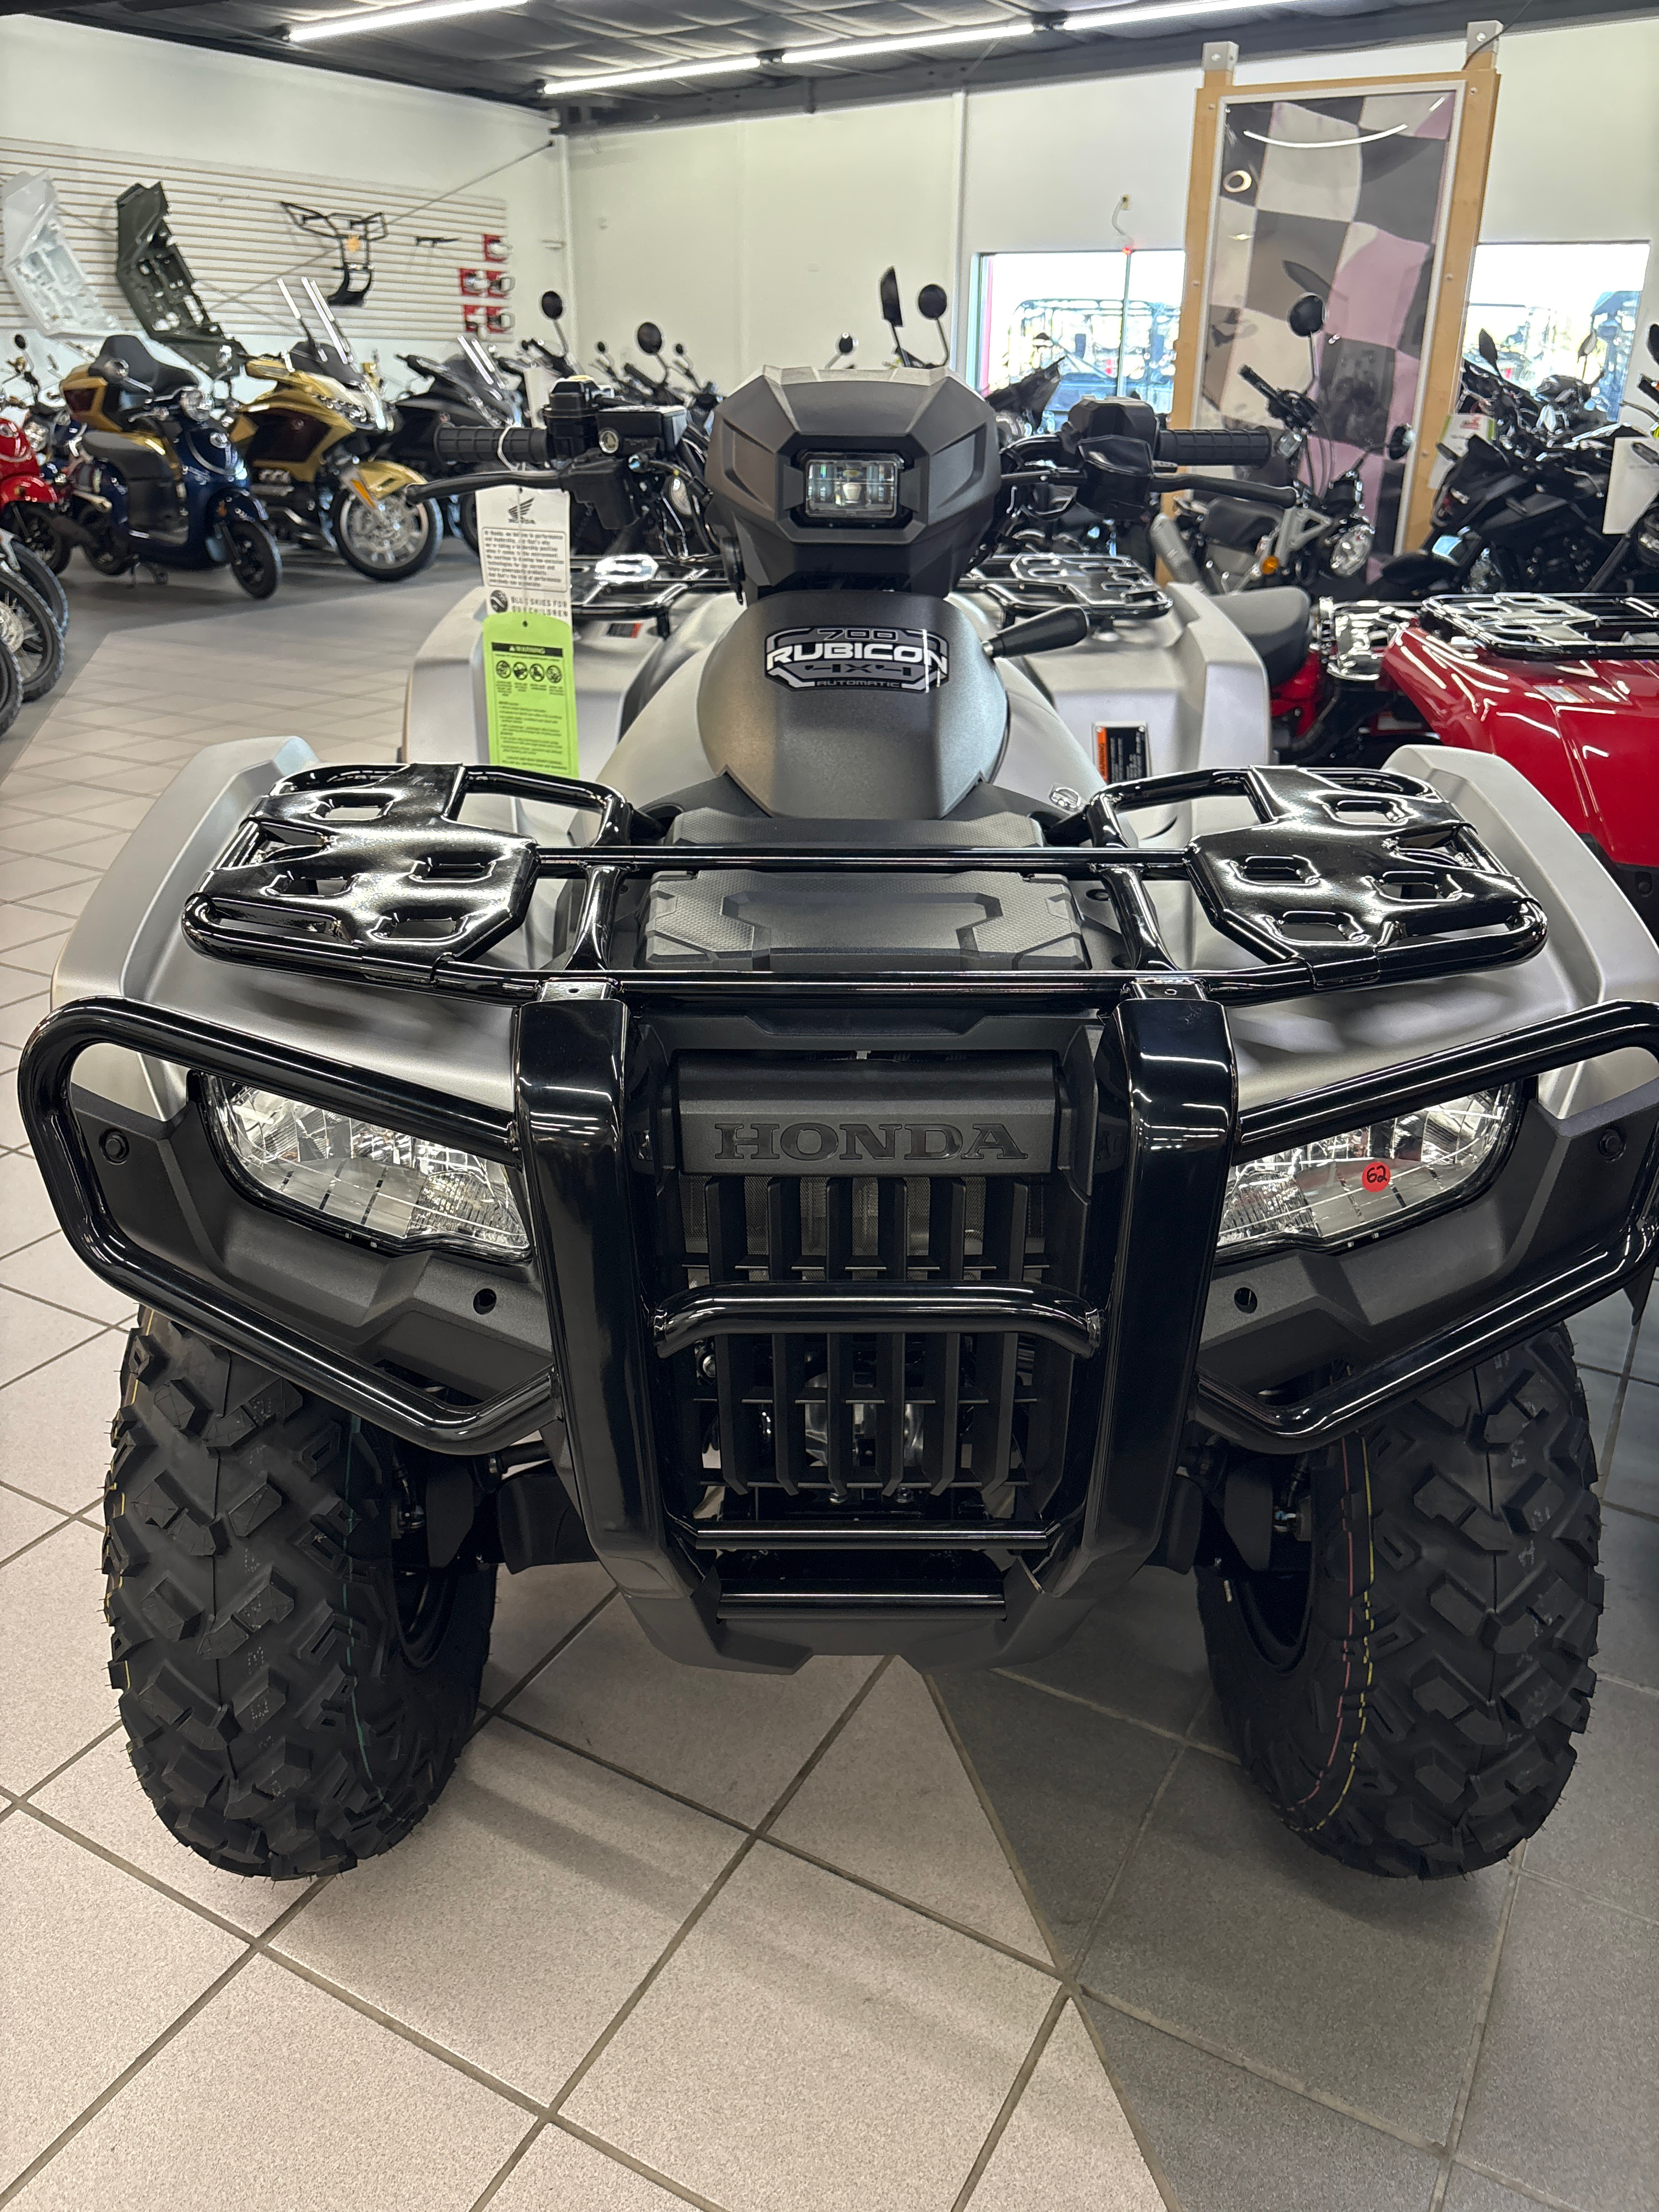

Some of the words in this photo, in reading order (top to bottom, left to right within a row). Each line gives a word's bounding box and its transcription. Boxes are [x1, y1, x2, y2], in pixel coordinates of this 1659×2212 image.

[817, 629, 899, 641] 700
[766, 642, 947, 674] RUBICON
[714, 1122, 1028, 1160] HONDA
[1367, 1164, 1387, 1183] 62
